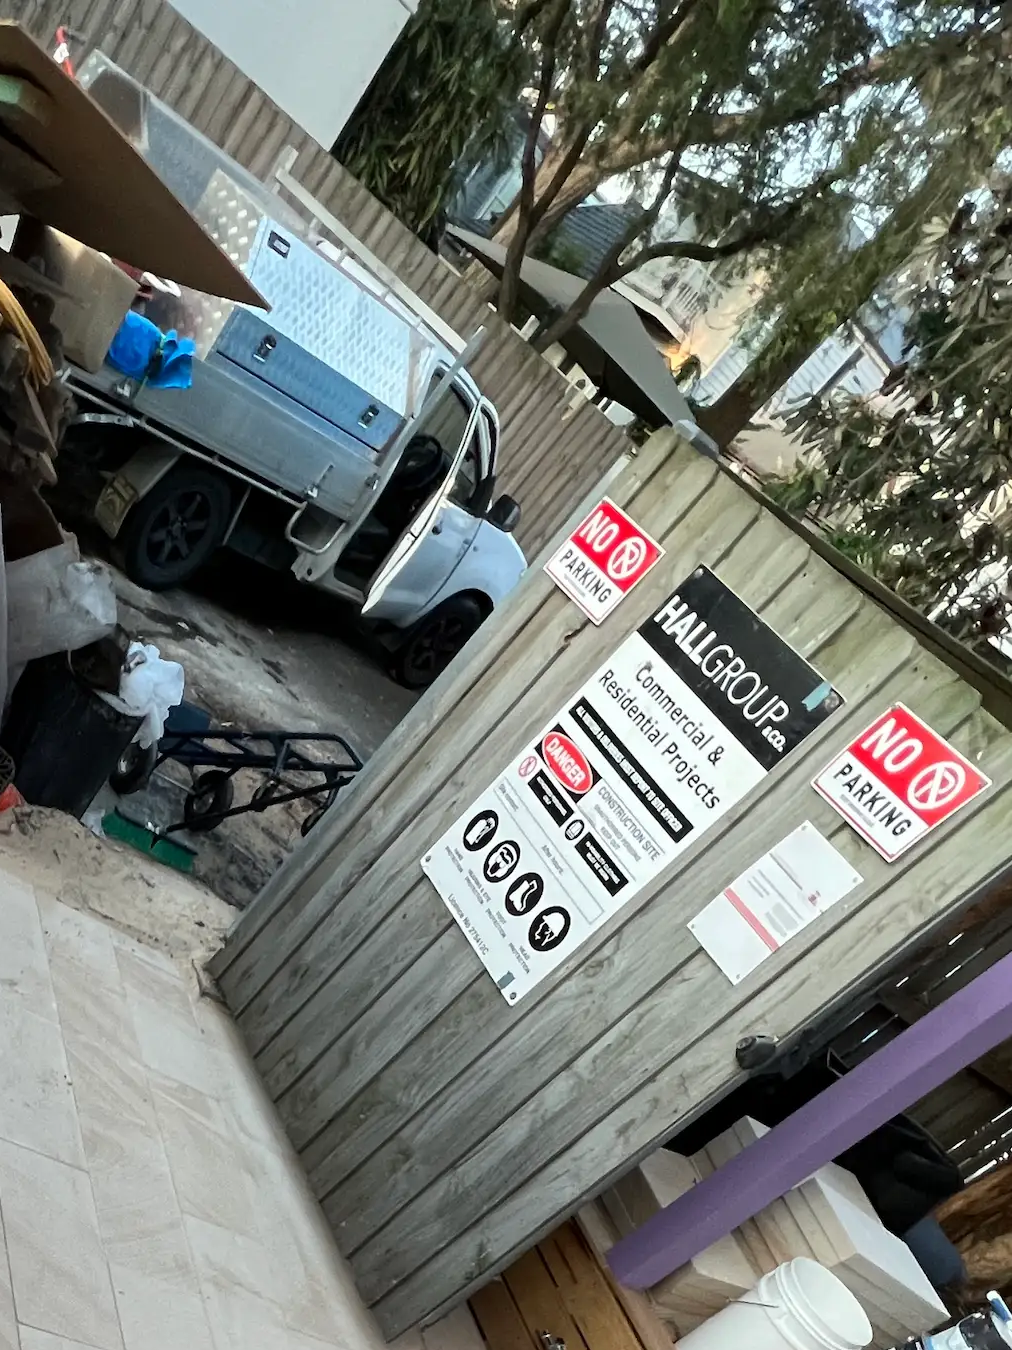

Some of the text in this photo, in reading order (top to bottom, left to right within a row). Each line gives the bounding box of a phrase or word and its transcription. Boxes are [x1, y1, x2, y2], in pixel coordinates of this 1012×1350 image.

[578, 508, 622, 555] NO
[559, 548, 612, 605] PARKING
[597, 667, 724, 814] Residential Projects
[633, 662, 729, 767] Commercial &
[859, 716, 929, 777] NO
[544, 736, 587, 788] DANGER
[596, 784, 646, 844] CONSTRUCTION
[640, 839, 660, 861] SITE
[832, 762, 914, 838] PARKING
